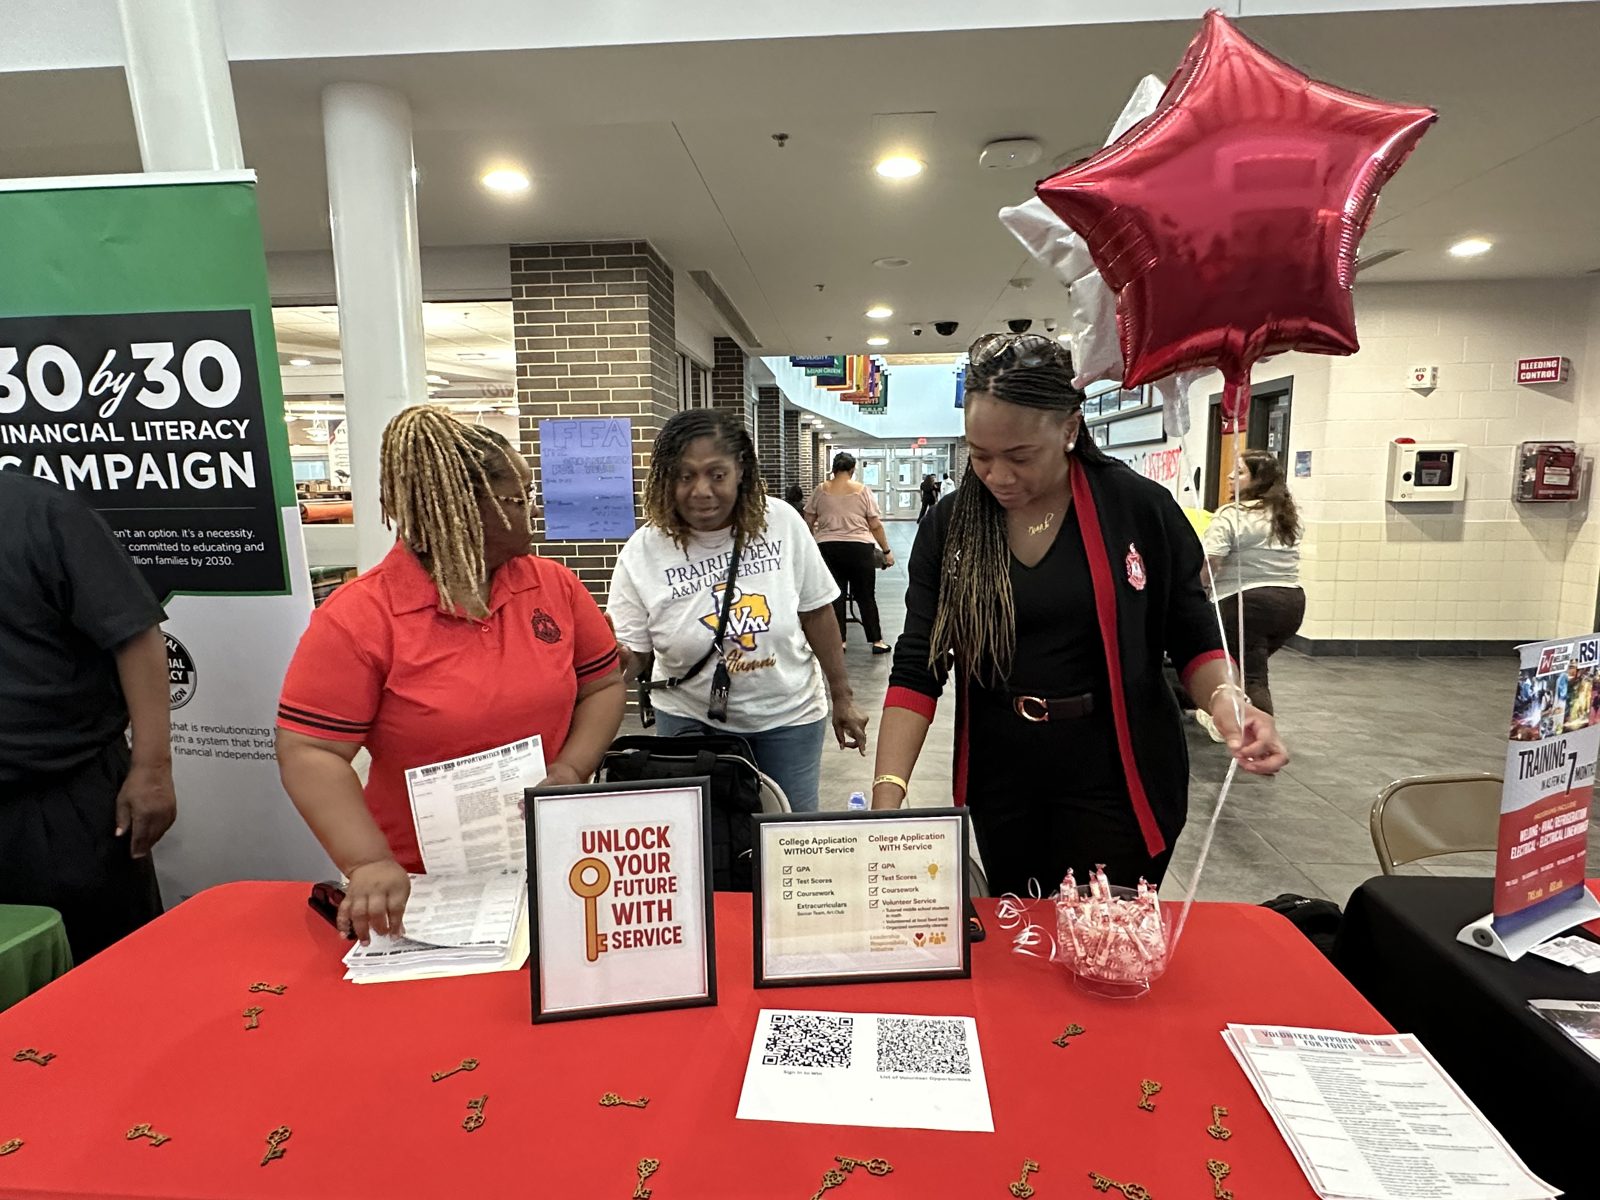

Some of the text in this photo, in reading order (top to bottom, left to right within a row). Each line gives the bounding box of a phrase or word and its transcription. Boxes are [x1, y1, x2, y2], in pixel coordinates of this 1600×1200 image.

[1520, 360, 1558, 370] BLEEDING
[88, 349, 136, 418] by
[131, 339, 242, 409] 30
[1520, 370, 1556, 380] CONTROL
[131, 419, 250, 442] LITERACY
[552, 420, 629, 448] FFA
[134, 530, 146, 538] an
[148, 528, 179, 539] option.
[181, 528, 195, 538] It's
[206, 528, 256, 540] necessity.
[128, 542, 178, 552] committed
[181, 543, 190, 552] to
[192, 542, 241, 554] educating
[244, 542, 265, 552] and
[155, 555, 189, 565] families
[191, 556, 201, 567] by
[205, 556, 235, 566] 2030.
[665, 551, 733, 586] PRAIRIE
[671, 557, 782, 600] A&M UNIERSITY
[1579, 640, 1598, 662] RSI
[169, 670, 183, 681] CY
[191, 723, 198, 732] is
[201, 725, 270, 737] revolutionizing
[196, 737, 229, 746] system
[232, 738, 251, 747] that
[254, 739, 276, 748] brid
[174, 746, 212, 757] financial
[1518, 740, 1567, 780] TRAINING
[1566, 752, 1578, 795] 7
[581, 825, 671, 853] UNLOCK
[779, 836, 858, 847] College Application
[868, 833, 945, 843] College Application
[784, 846, 855, 855] WITHOUT Service
[879, 843, 933, 852] WITH Service
[613, 852, 671, 876] YOUR
[613, 876, 678, 897] FUTURE
[882, 886, 919, 894] Coursework
[797, 889, 835, 897] Coursework
[797, 901, 847, 909] Extracurriculars
[611, 899, 672, 926] WITH
[612, 926, 682, 949] SERVICE
[1261, 1030, 1392, 1047] VOLUNTEER OPPORTUNITIES
[1326, 1042, 1357, 1050] YOUTH
